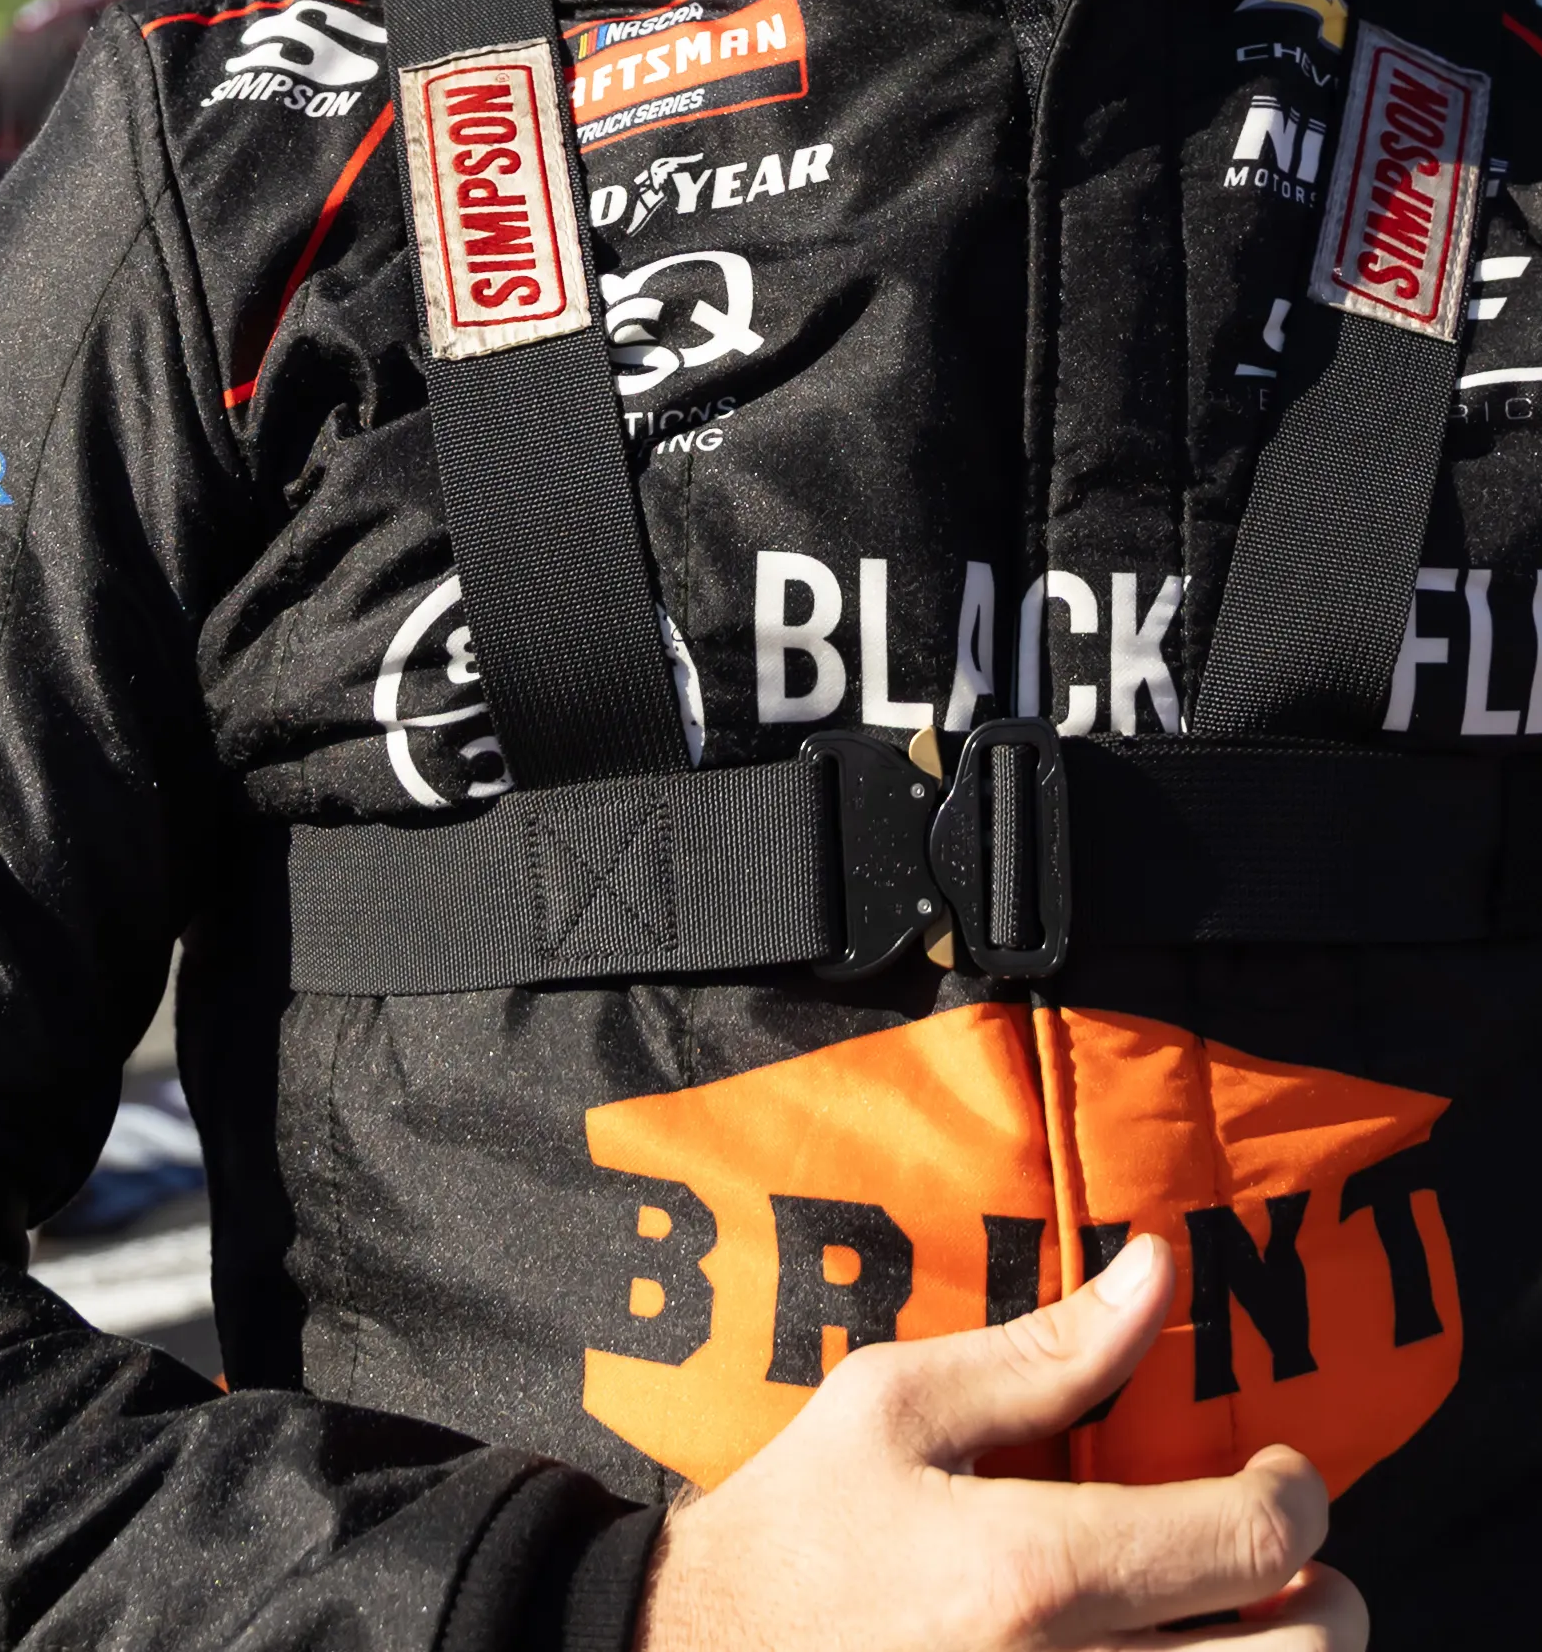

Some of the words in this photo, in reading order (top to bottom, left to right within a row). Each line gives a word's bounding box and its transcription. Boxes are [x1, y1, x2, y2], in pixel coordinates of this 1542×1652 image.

[567, 13, 787, 108] AFTSMAN
[604, 2, 705, 45] NASCAR
[200, 71, 363, 118] SIMPSON
[575, 108, 638, 145] TRUCK
[634, 88, 706, 125] SERIES
[443, 83, 542, 309] SIMPSON
[589, 143, 835, 236] DYEAR
[1357, 67, 1450, 300] SIMPSON
[623, 395, 737, 441] TIONS
[754, 550, 1194, 737] BLACK
